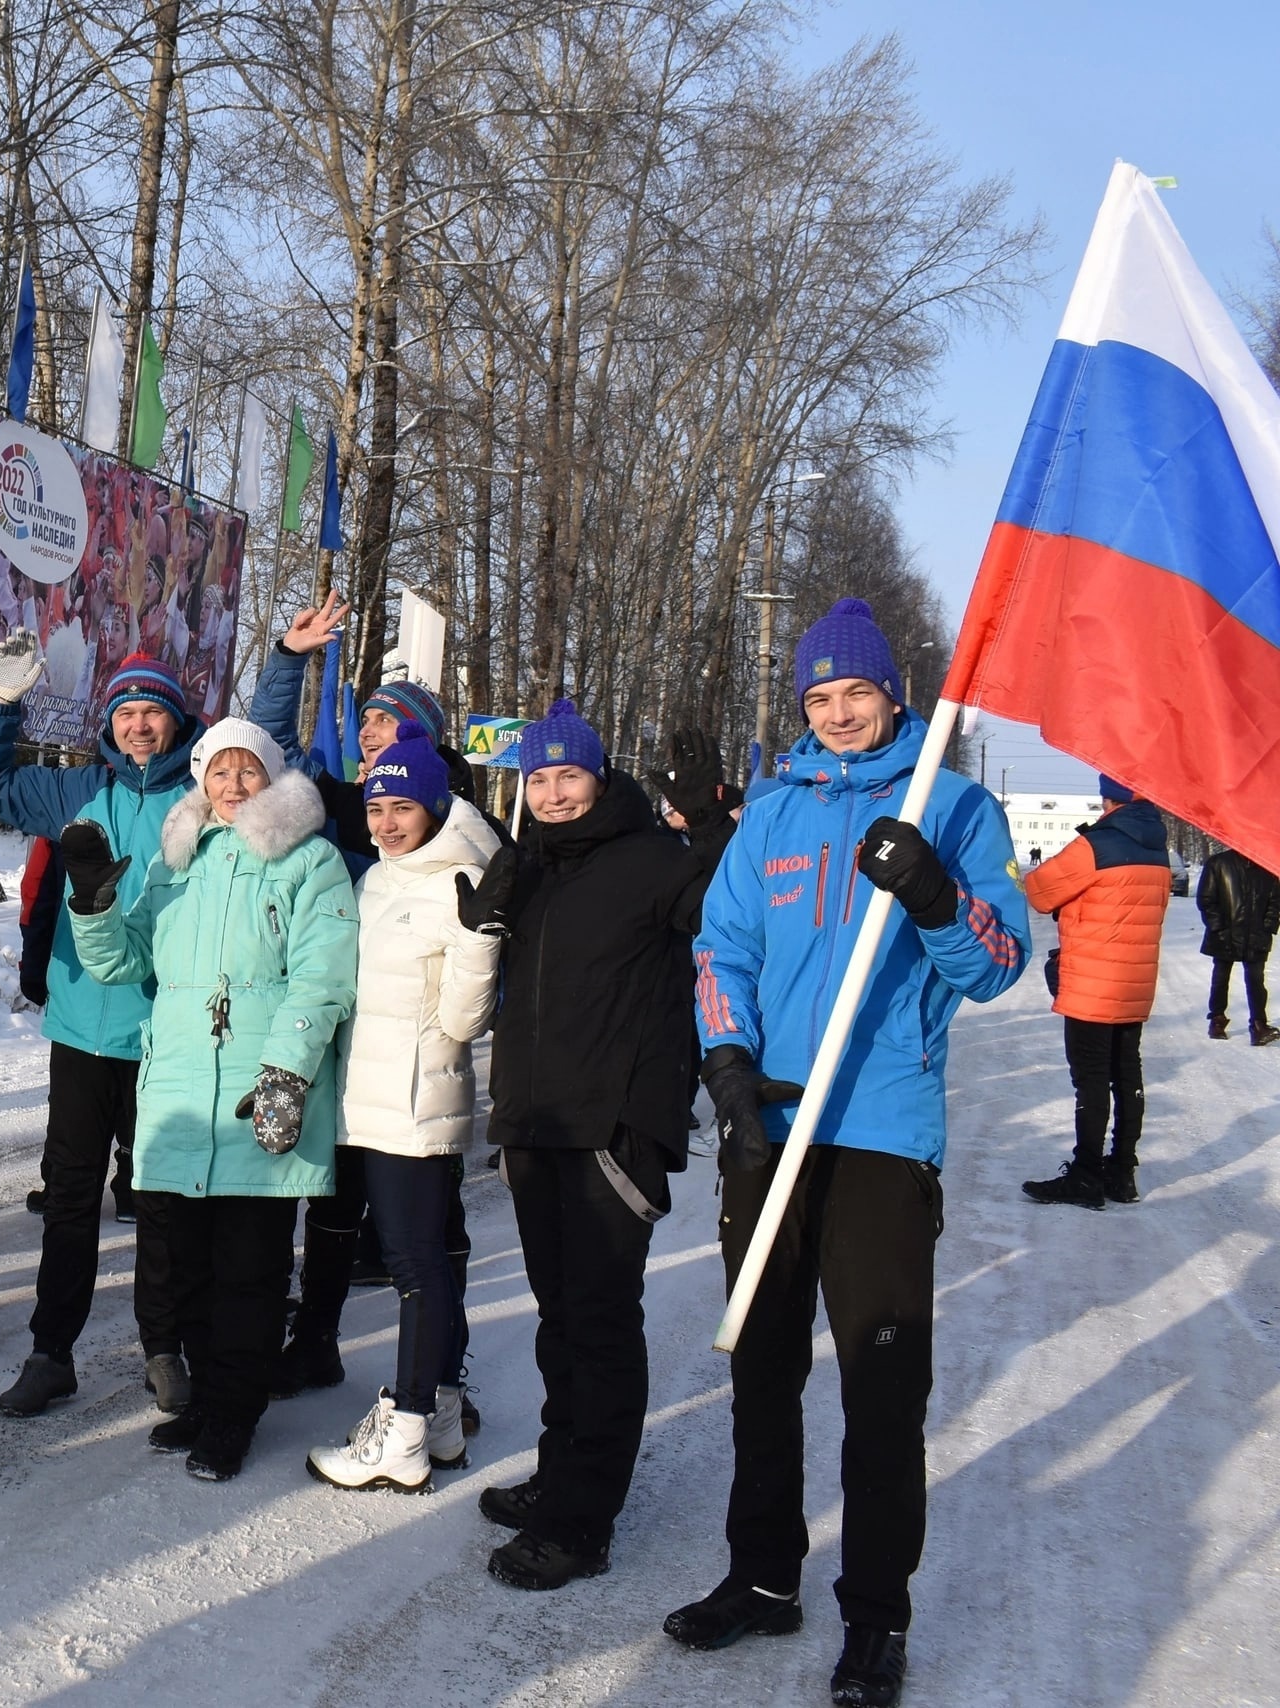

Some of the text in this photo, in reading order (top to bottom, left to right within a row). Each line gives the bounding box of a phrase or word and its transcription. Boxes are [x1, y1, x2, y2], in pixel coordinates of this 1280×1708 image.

[12, 497, 77, 531] ГОД КУЛЬТУРНОГО
[31, 521, 76, 551] НАСЛЕДИЯ
[30, 544, 74, 565] НАРОДОВ РОССИИ
[40, 695, 77, 714] разные
[78, 703, 87, 716] и
[22, 709, 47, 731] Мы
[47, 719, 84, 738] разные
[86, 726, 94, 739] и
